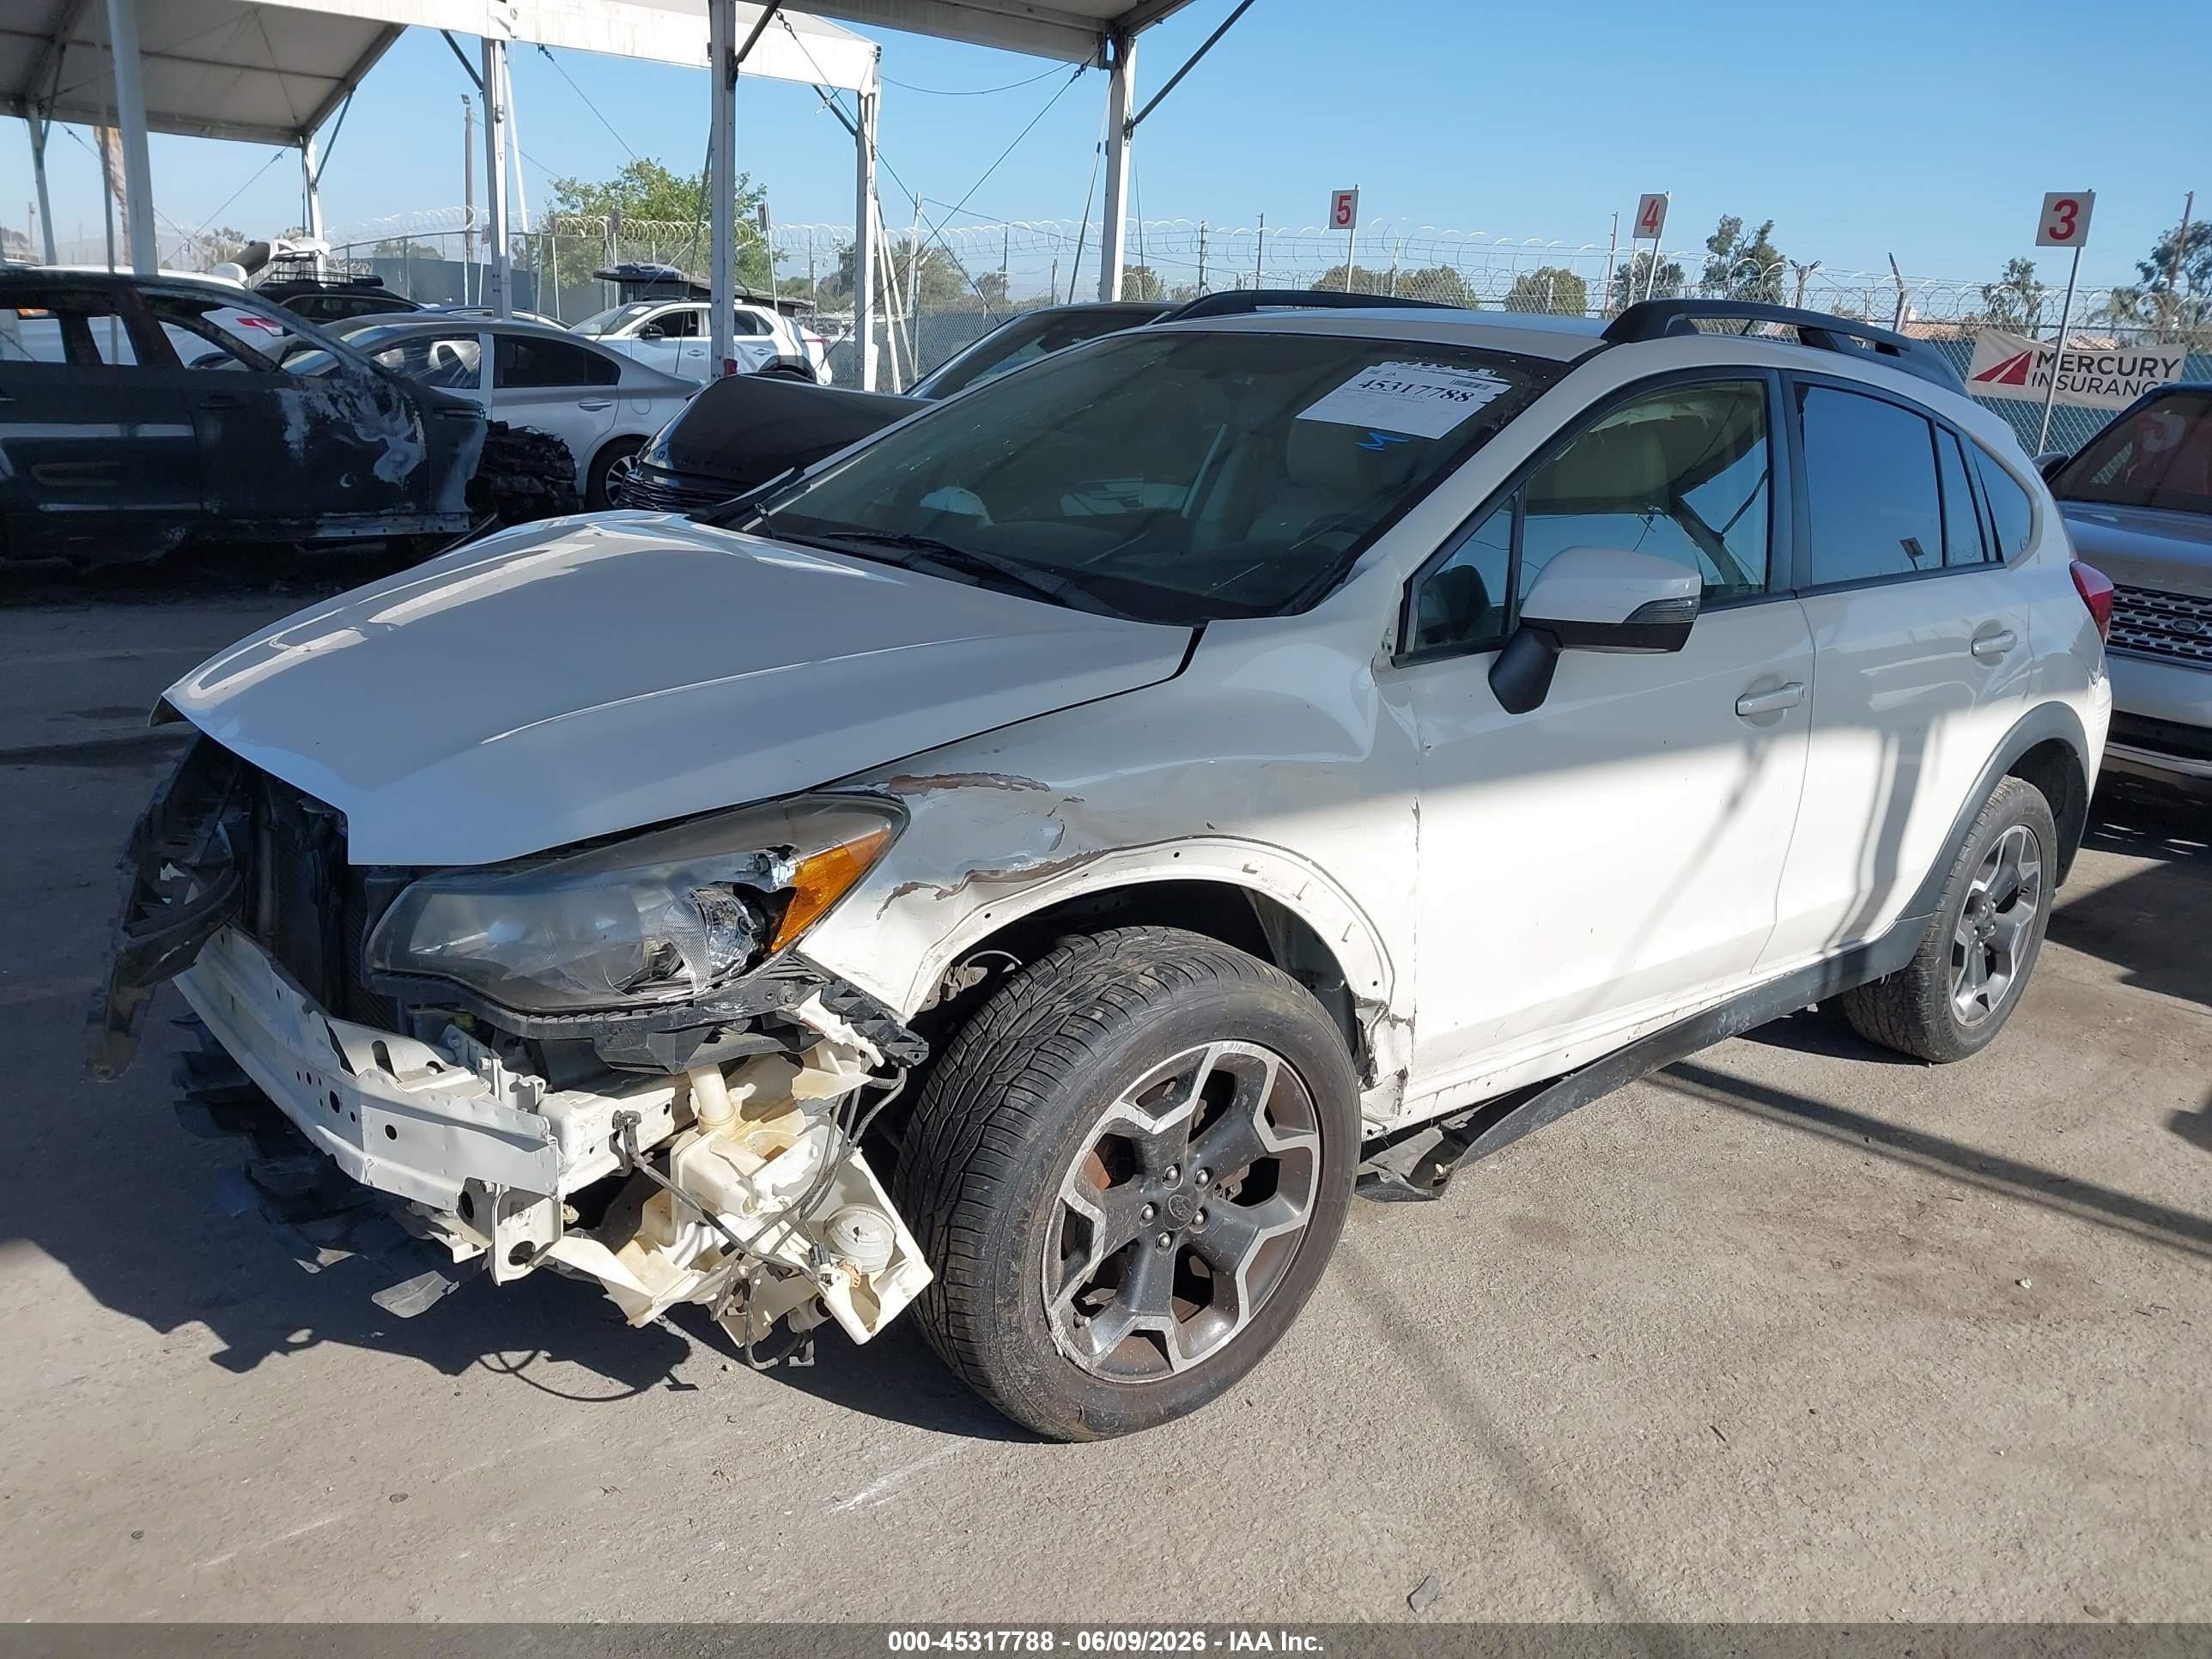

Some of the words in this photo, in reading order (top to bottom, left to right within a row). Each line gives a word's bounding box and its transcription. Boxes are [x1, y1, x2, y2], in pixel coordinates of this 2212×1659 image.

[1336, 194, 1352, 225] 5
[1641, 198, 1660, 234] 4
[2048, 198, 2080, 240] 3
[2036, 349, 2180, 379] MERCURY
[1358, 379, 1475, 403] 45317788
[2032, 371, 2172, 397] INSURANC
